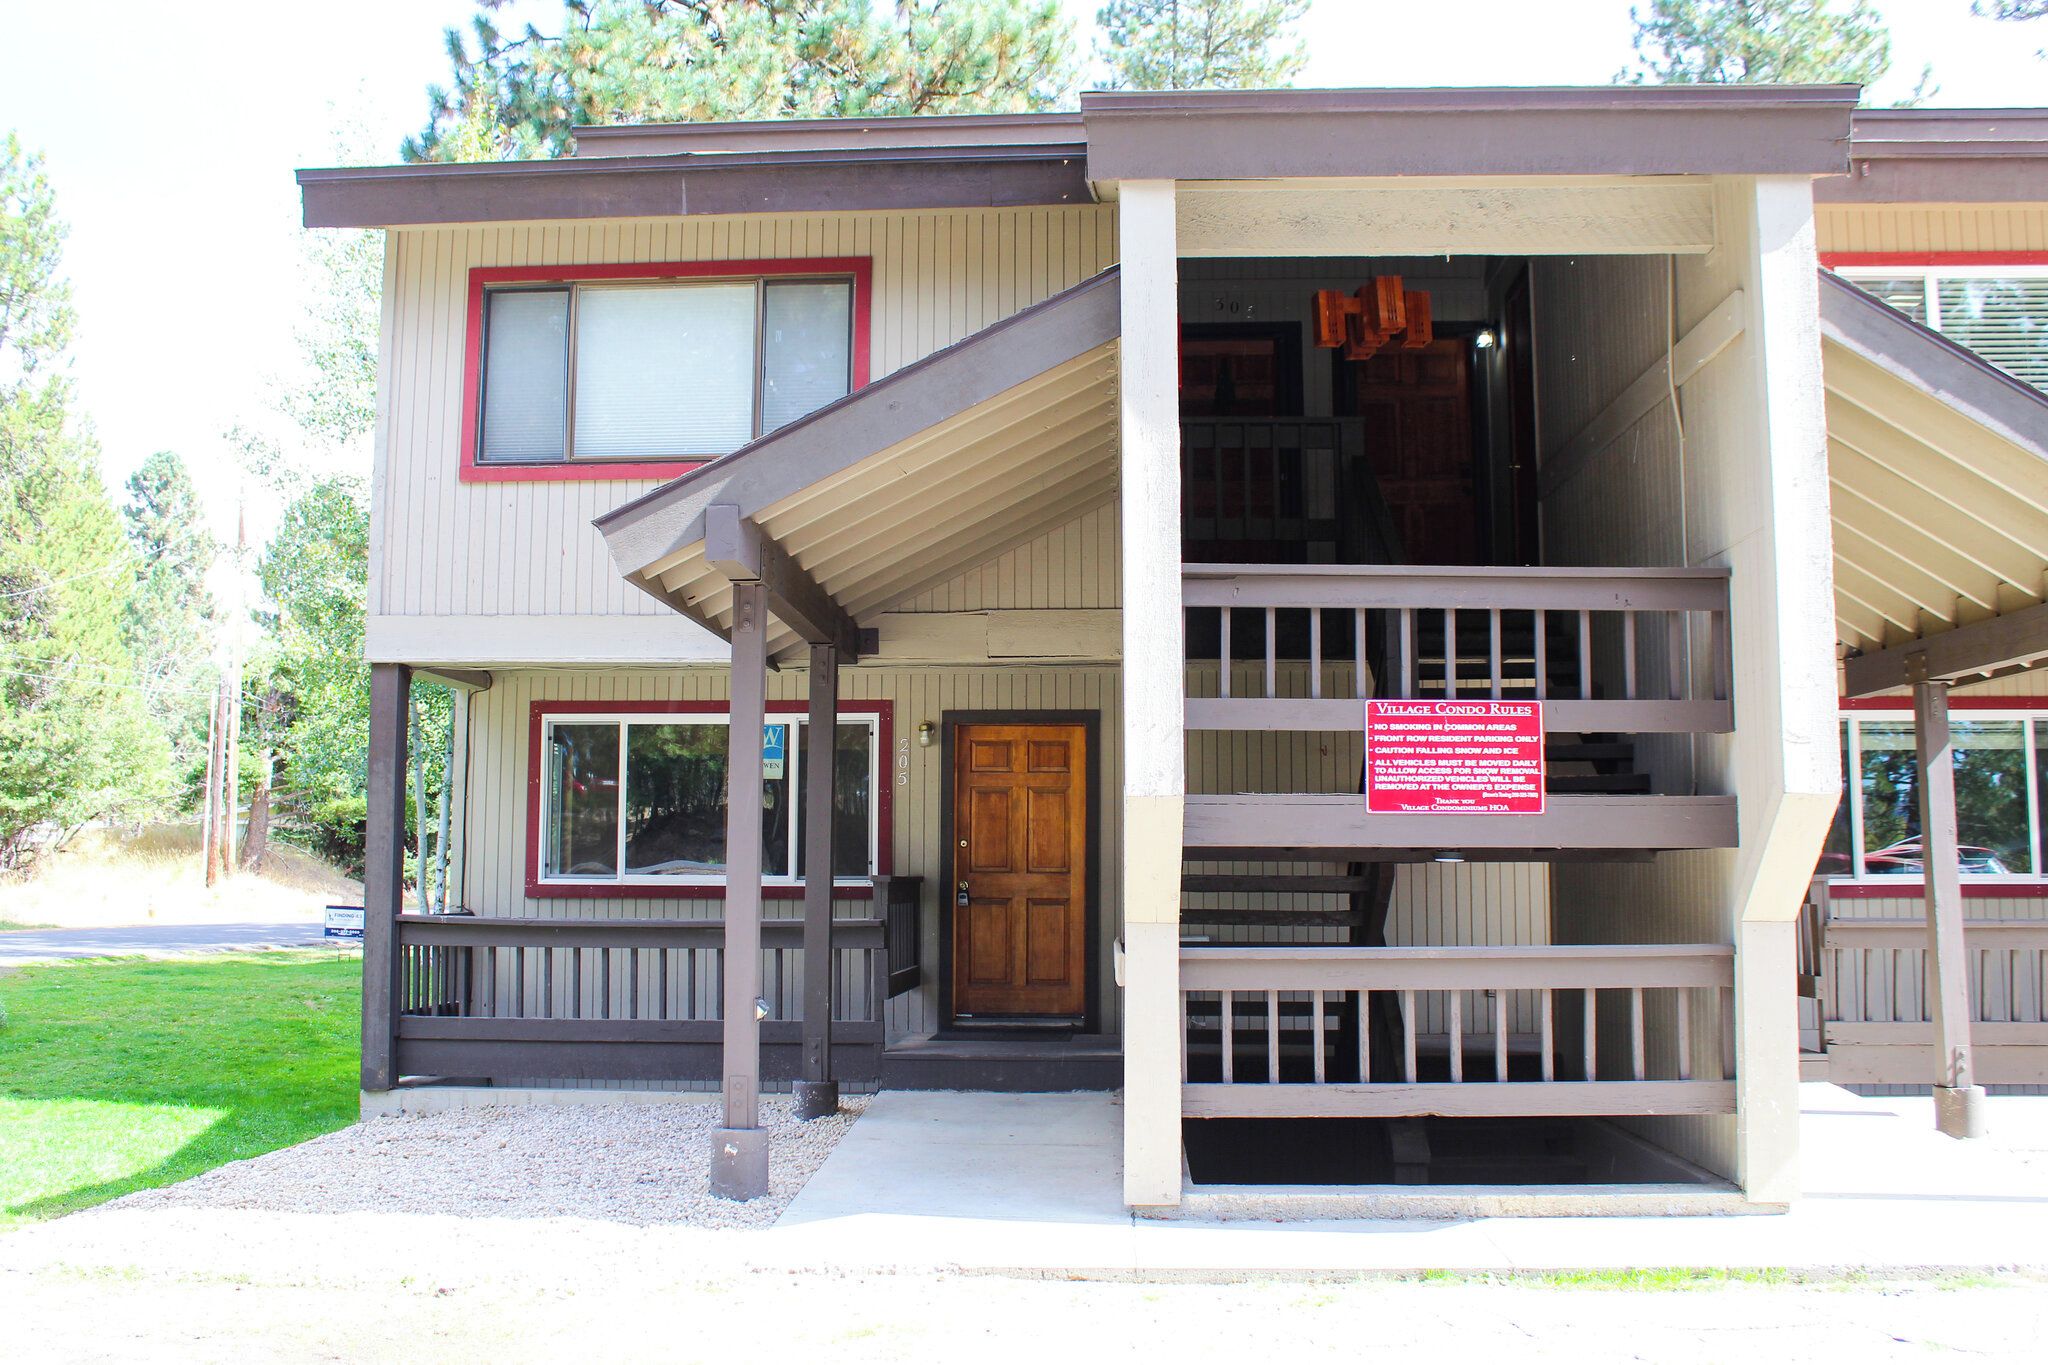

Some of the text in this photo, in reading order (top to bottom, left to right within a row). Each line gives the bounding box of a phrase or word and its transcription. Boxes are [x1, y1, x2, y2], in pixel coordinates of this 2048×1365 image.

[1376, 703, 1532, 714] VILLAGE CONDO RULES
[898, 738, 910, 786] 205
